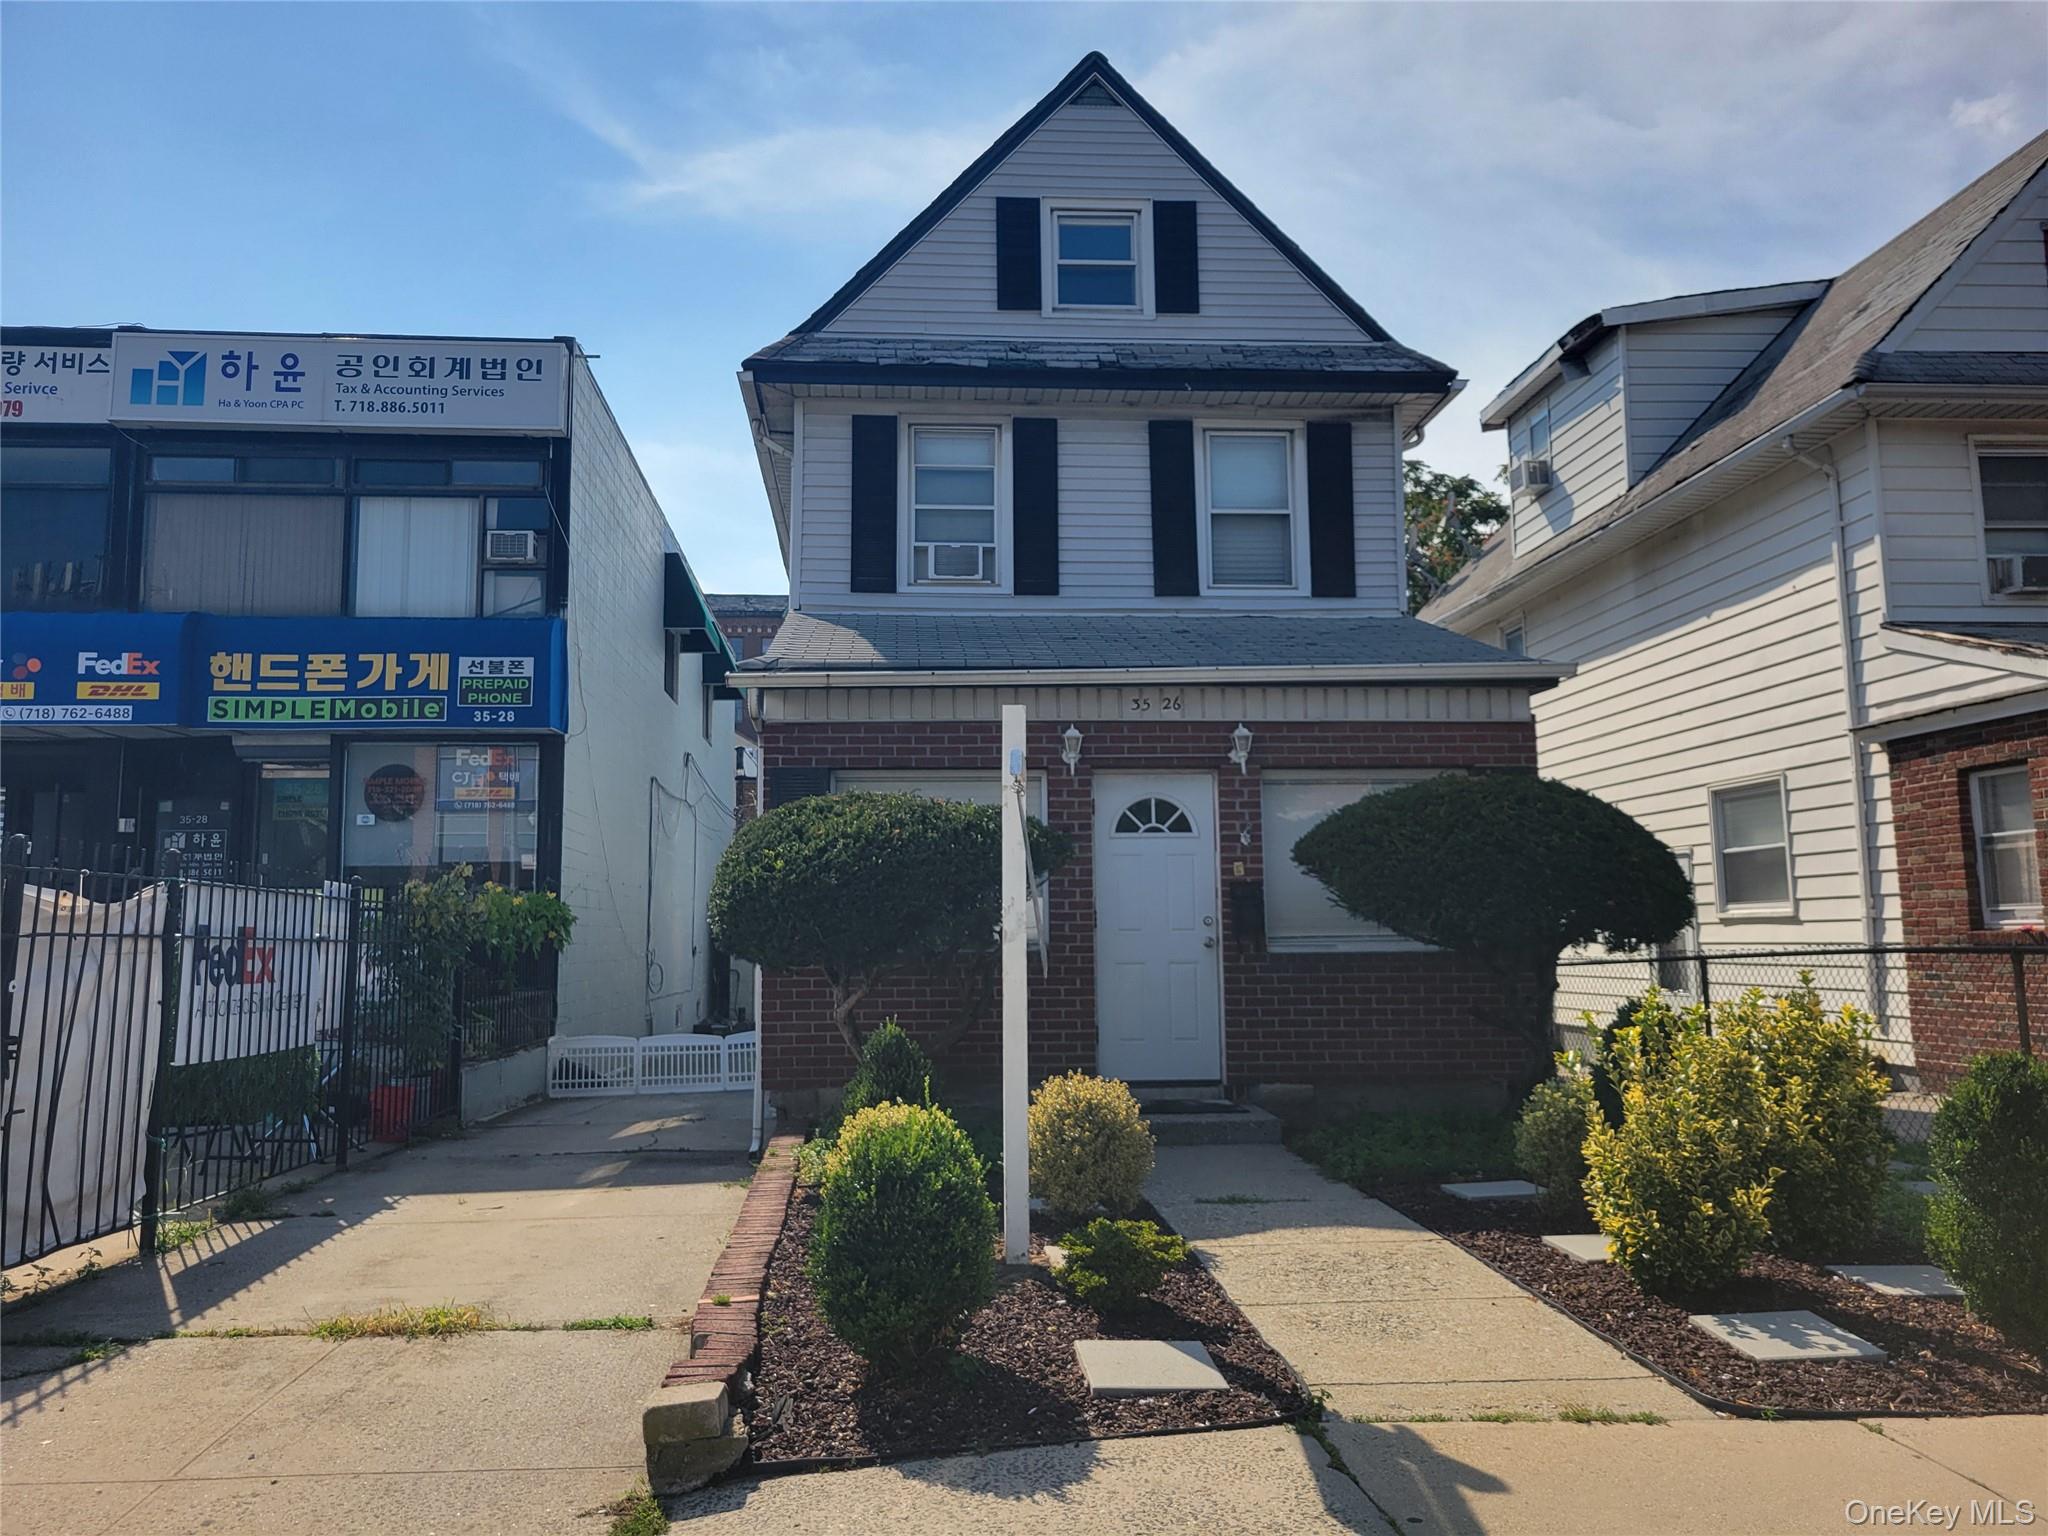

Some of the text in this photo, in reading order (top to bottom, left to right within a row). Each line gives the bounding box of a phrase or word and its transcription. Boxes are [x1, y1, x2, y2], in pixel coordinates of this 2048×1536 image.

[34, 352, 110, 375] 서비스
[335, 354, 543, 382] 공인회계법인
[4, 382, 58, 395] Serivce
[336, 383, 505, 398] Tax & Accounting Services
[0, 400, 23, 417] 79
[218, 399, 305, 409] Ha & Yoon CPA PC
[350, 401, 445, 414] 718.886.5011
[78, 652, 160, 675] FedEx
[461, 678, 529, 690] PREPAID
[88, 685, 150, 697] DHL
[467, 693, 523, 704] PHONE
[1131, 697, 1182, 711] 35 26
[19, 707, 131, 720] (718) 762-6488
[473, 710, 515, 722] 35-28
[455, 749, 514, 766] FedEx
[179, 815, 208, 824] 35-28
